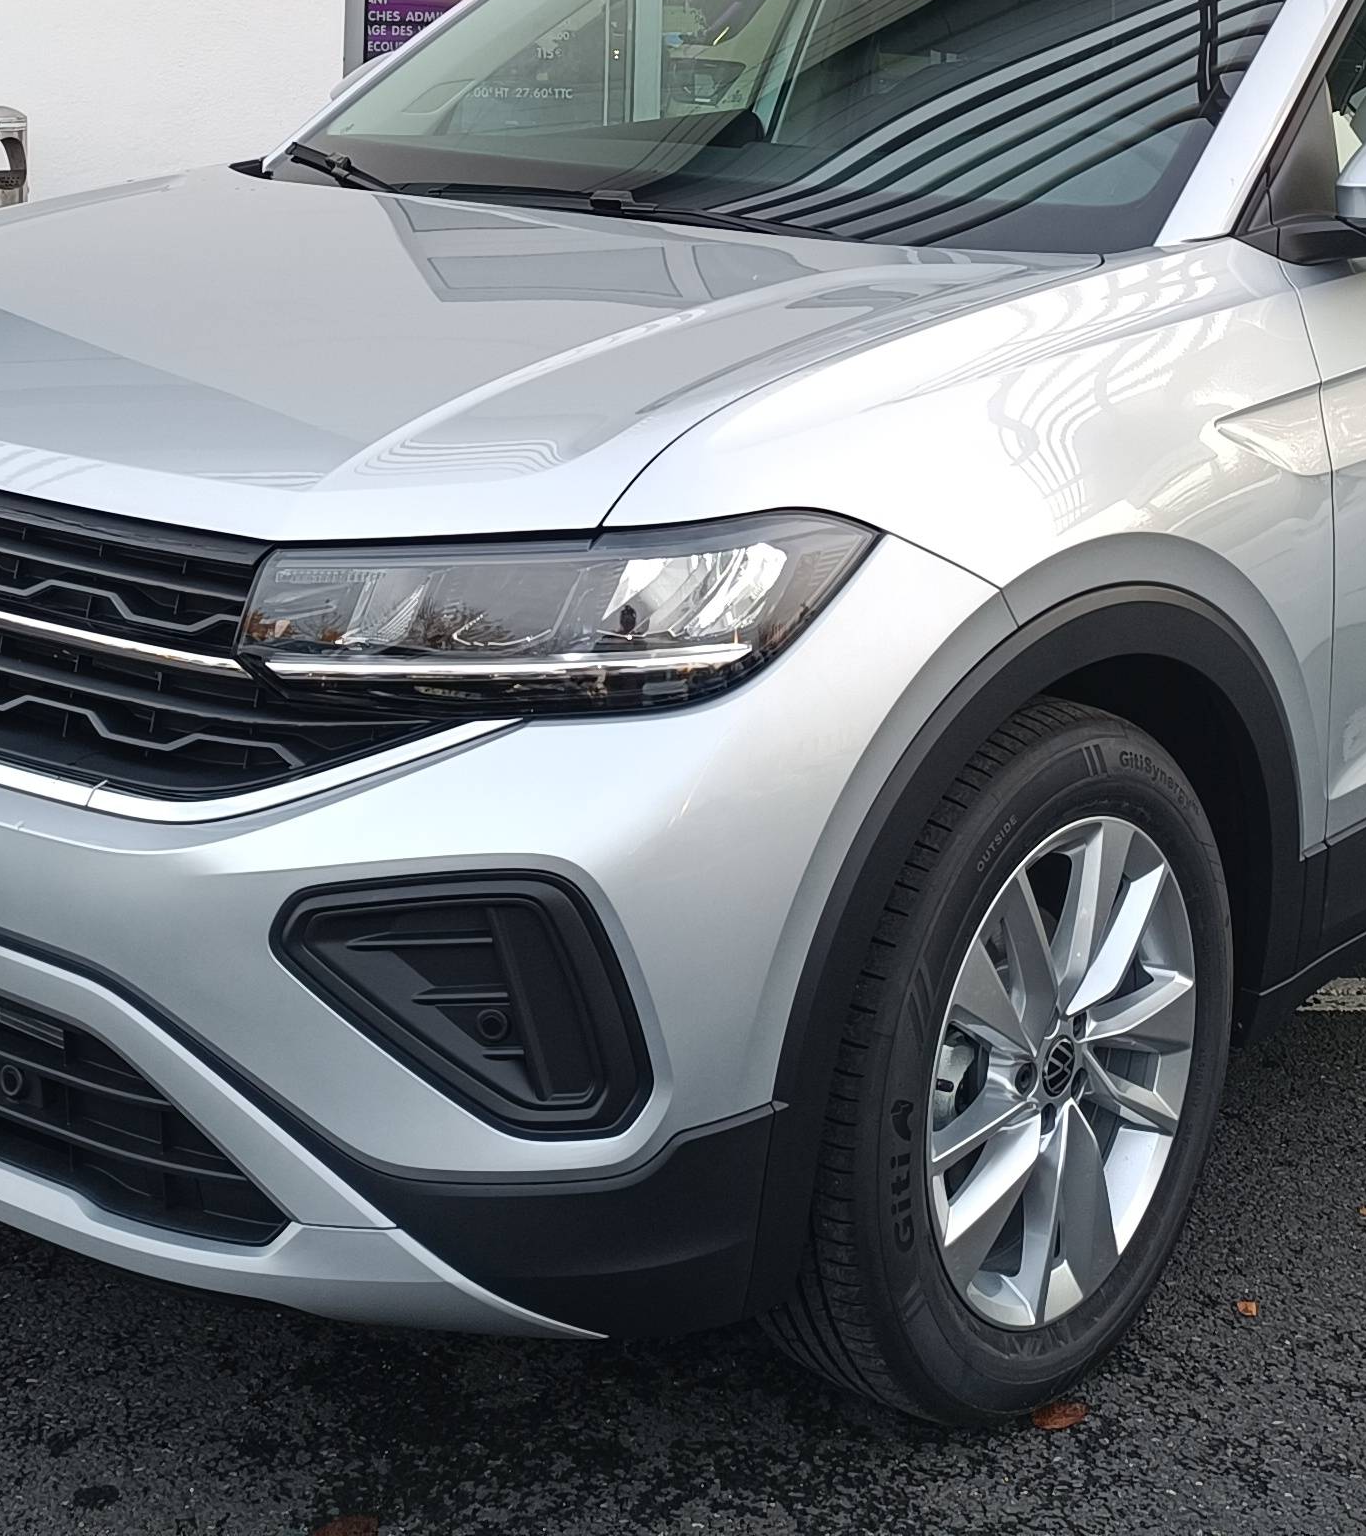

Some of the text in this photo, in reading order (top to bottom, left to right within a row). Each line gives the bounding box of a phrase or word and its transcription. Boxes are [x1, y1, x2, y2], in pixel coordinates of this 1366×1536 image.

[368, 10, 400, 22] CHES
[391, 25, 413, 36] DES
[976, 813, 1019, 873] OUTSIDE
[890, 1152, 915, 1252] Giti
